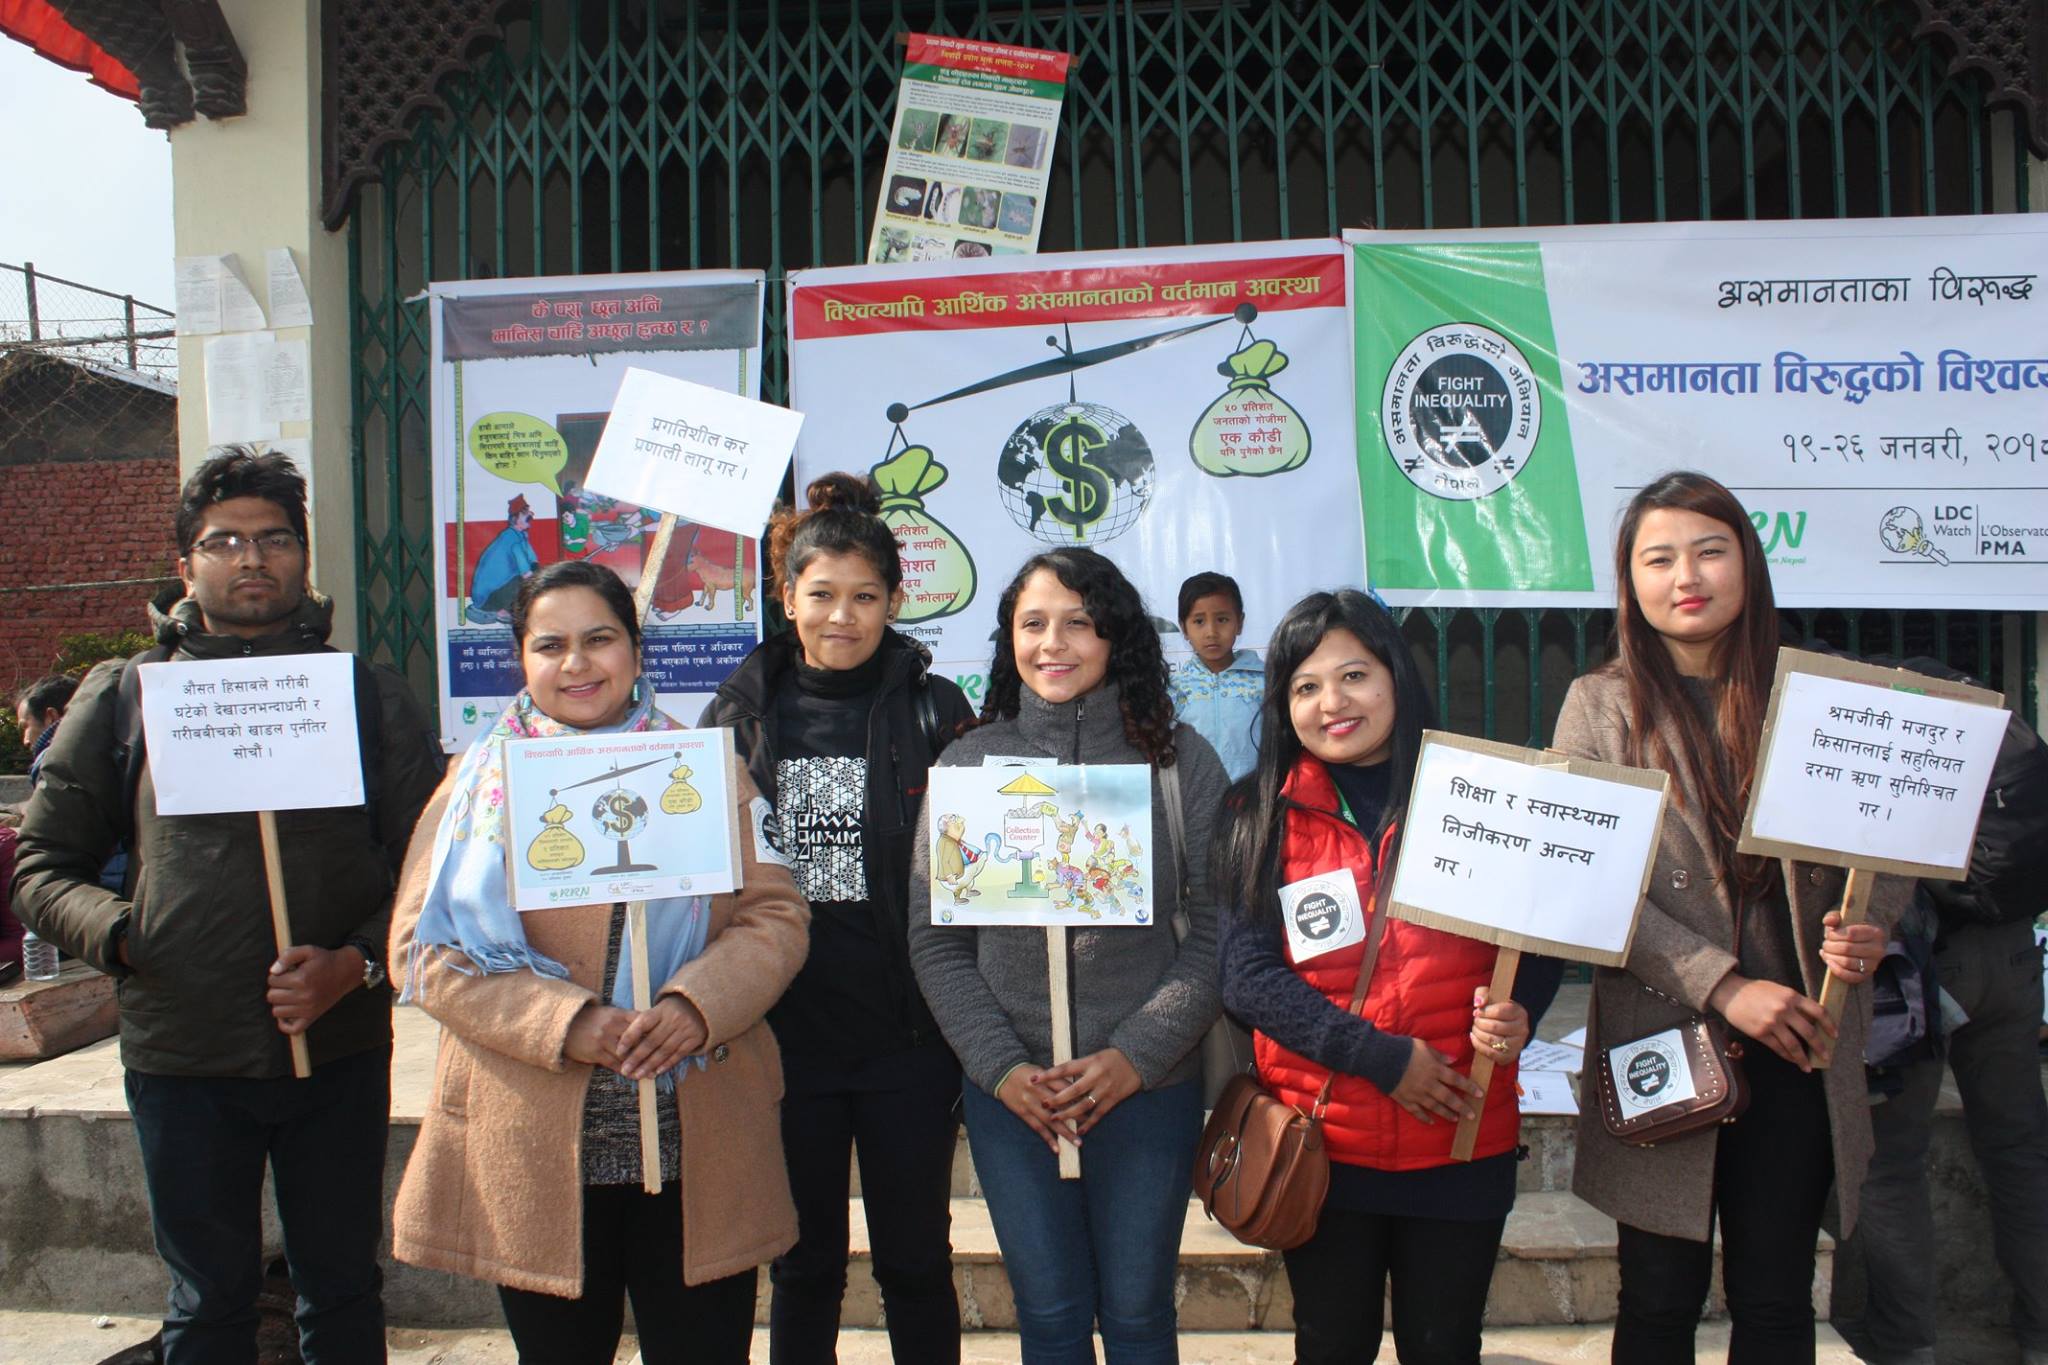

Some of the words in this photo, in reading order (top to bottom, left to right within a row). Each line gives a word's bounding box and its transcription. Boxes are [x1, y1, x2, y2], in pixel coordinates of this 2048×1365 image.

[933, 291, 1008, 316] आर्थिक
[1016, 281, 1154, 311] असमानताको
[1162, 279, 1238, 302] वर्तमान
[1245, 276, 1321, 297] अवस्था
[532, 300, 549, 318] के
[554, 301, 583, 320] पशु
[625, 295, 662, 314] अनि
[492, 323, 543, 343] मानिस
[636, 319, 677, 340] हुन्छ
[681, 320, 694, 334] र
[1438, 377, 1484, 391] FIGHT
[1577, 362, 1762, 395] असमानता
[1242, 401, 1273, 412] प्रतिशत
[1391, 351, 1421, 445] असमानता
[1415, 394, 1507, 408] INEQUALITY
[1213, 414, 1250, 425] जनताको
[651, 417, 722, 447] प्रगतिशील
[724, 436, 750, 455] कर
[1219, 432, 1242, 446] एक
[1248, 428, 1281, 443] कौडी
[1783, 434, 1864, 463] १९-२६
[1880, 427, 1968, 465] जनवरी,
[634, 437, 682, 462] प्रणाली
[684, 451, 715, 476] लागू
[717, 460, 738, 477] गर
[1935, 506, 1972, 520] LDC
[1934, 525, 1971, 536] Watch
[1981, 541, 2025, 555] PMA
[711, 641, 744, 652] अधिकार
[183, 680, 216, 696] औसत
[222, 677, 269, 694] हिसाबले
[174, 703, 208, 719] घटेको
[313, 699, 321, 711] र
[1828, 706, 1894, 731] श्रमजीवी
[1902, 719, 1949, 745] मजदुर
[1956, 729, 1965, 743] र
[1812, 728, 1893, 763] किसानलाई
[1900, 748, 1965, 774] सहुलियत
[1805, 762, 1843, 782] दरमा
[1851, 770, 1881, 789] ऋण
[1889, 775, 1958, 801] सुनिश्चित
[1450, 776, 1497, 804] शिक्षा
[1506, 793, 1518, 810] र
[1527, 798, 1620, 830] स्वास्थ्यमा
[1859, 801, 1880, 818] गर
[1007, 826, 1040, 834] Collection
[1442, 814, 1531, 852] निजीकरण
[1539, 842, 1595, 866] अन्त्य
[1433, 856, 1460, 876] गर
[1297, 905, 1337, 922] INEQUALITY
[1303, 898, 1326, 912] FIGHT
[1629, 1062, 1667, 1080] INEQUALITY
[1635, 1056, 1657, 1070] FIGHT
